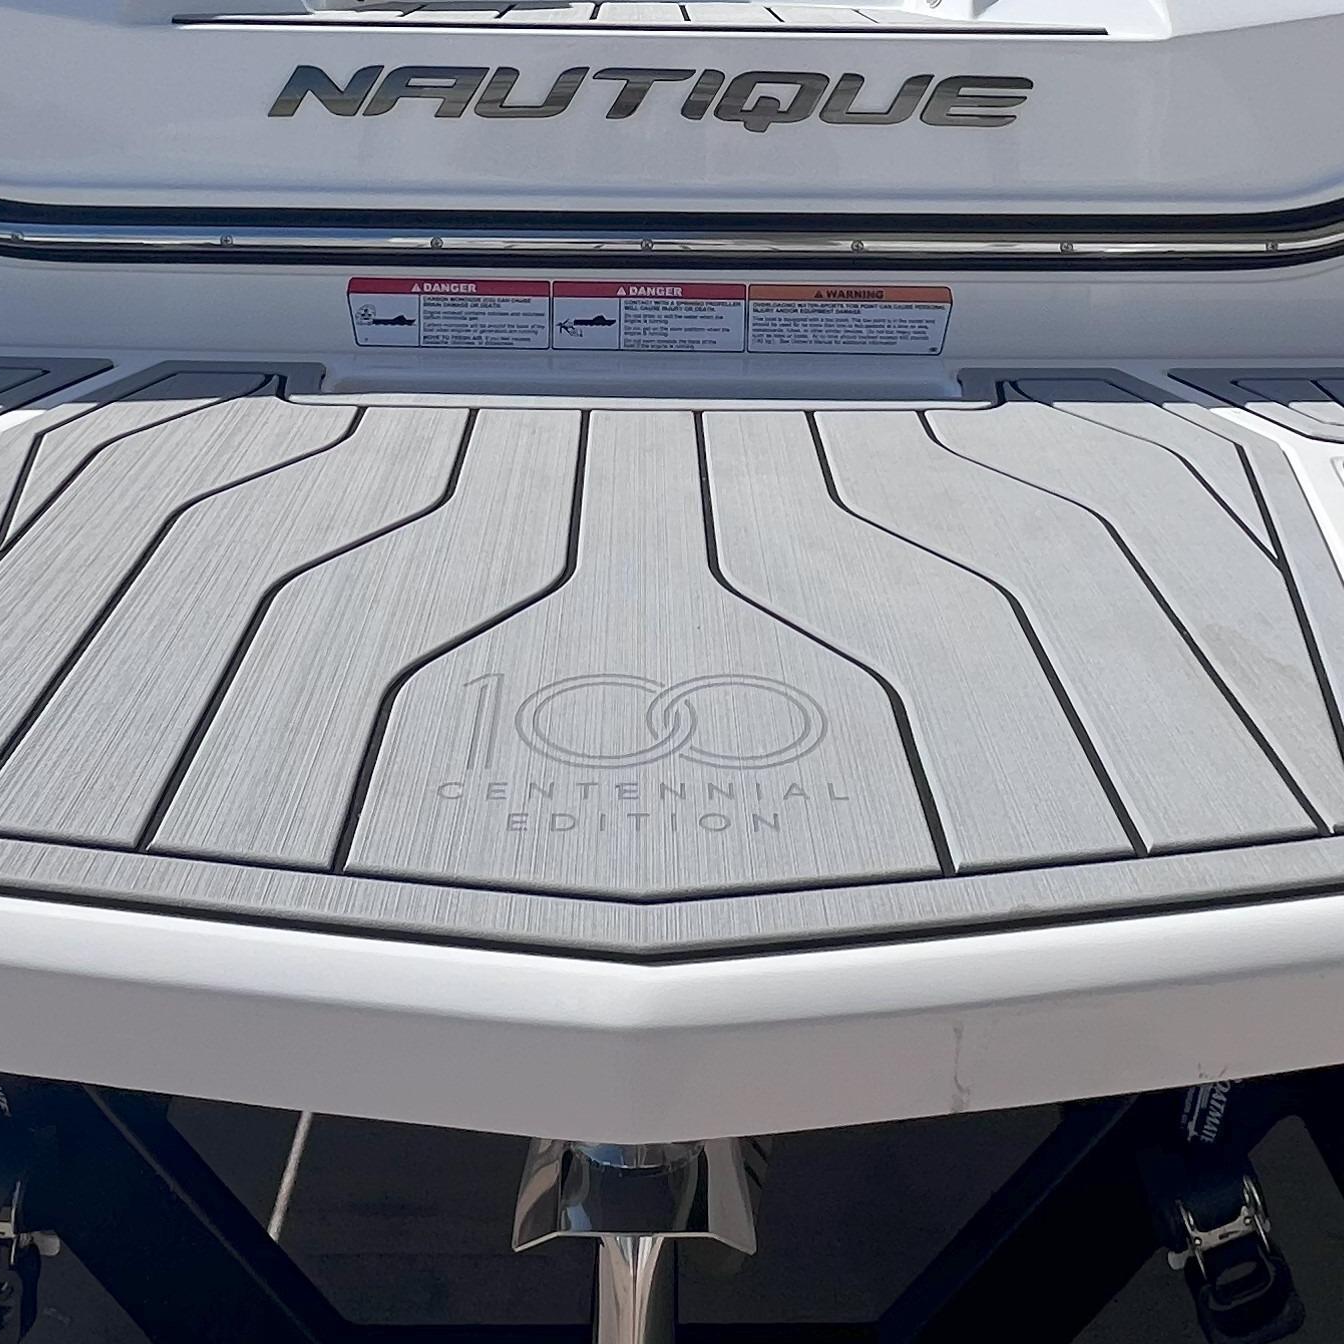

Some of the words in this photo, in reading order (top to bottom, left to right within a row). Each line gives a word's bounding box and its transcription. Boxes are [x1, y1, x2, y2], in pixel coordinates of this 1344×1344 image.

[267, 64, 1034, 134] NAUTIQUE
[423, 283, 477, 293] DANGER
[629, 286, 683, 297] DANGER
[826, 289, 884, 300] WARNING
[463, 673, 828, 770] 100
[436, 781, 850, 801] CENTENNIAL
[506, 812, 782, 833] EDITION
